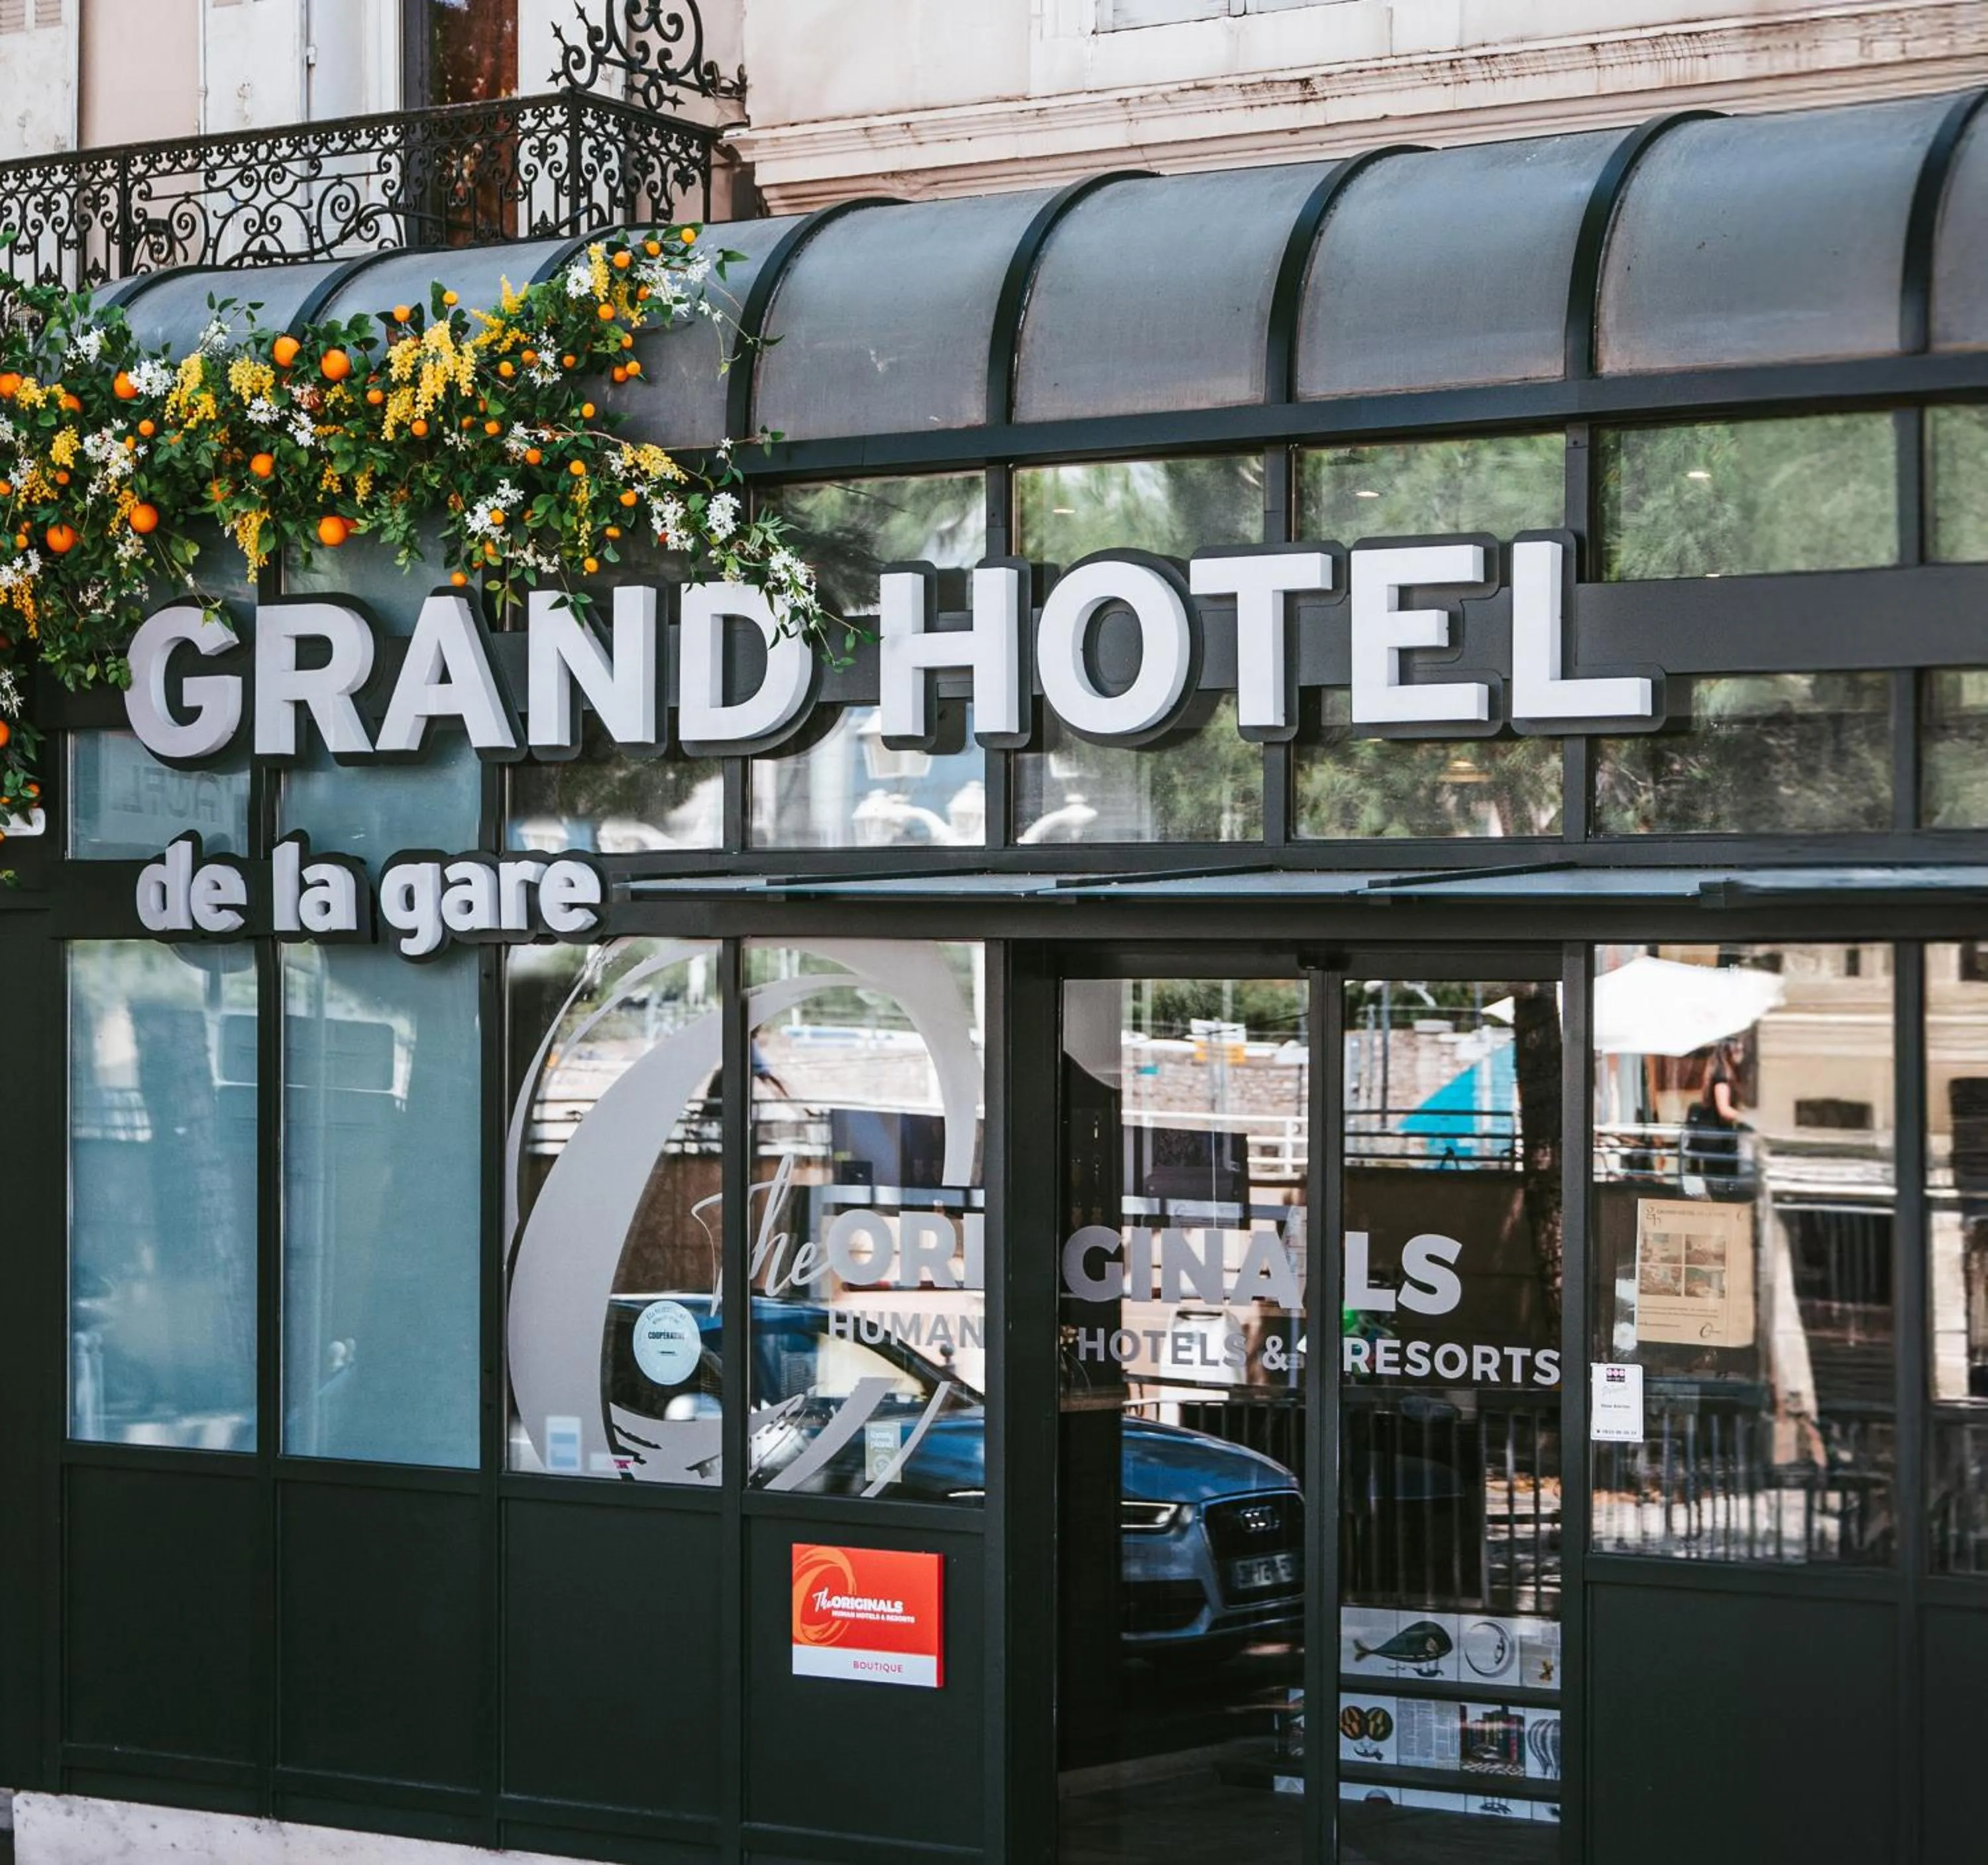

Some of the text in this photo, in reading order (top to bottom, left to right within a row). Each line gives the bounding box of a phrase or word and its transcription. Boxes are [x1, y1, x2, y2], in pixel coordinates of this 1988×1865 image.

[125, 541, 1652, 758] GRAND HOTEL
[137, 840, 601, 956] de la gare
[691, 1153, 830, 1317] The
[828, 1308, 1561, 1386] HUMAN HOTELS & RESORTS
[832, 1595, 903, 1613] ORIGINALS
[853, 1660, 903, 1673] BOUTIQUE
